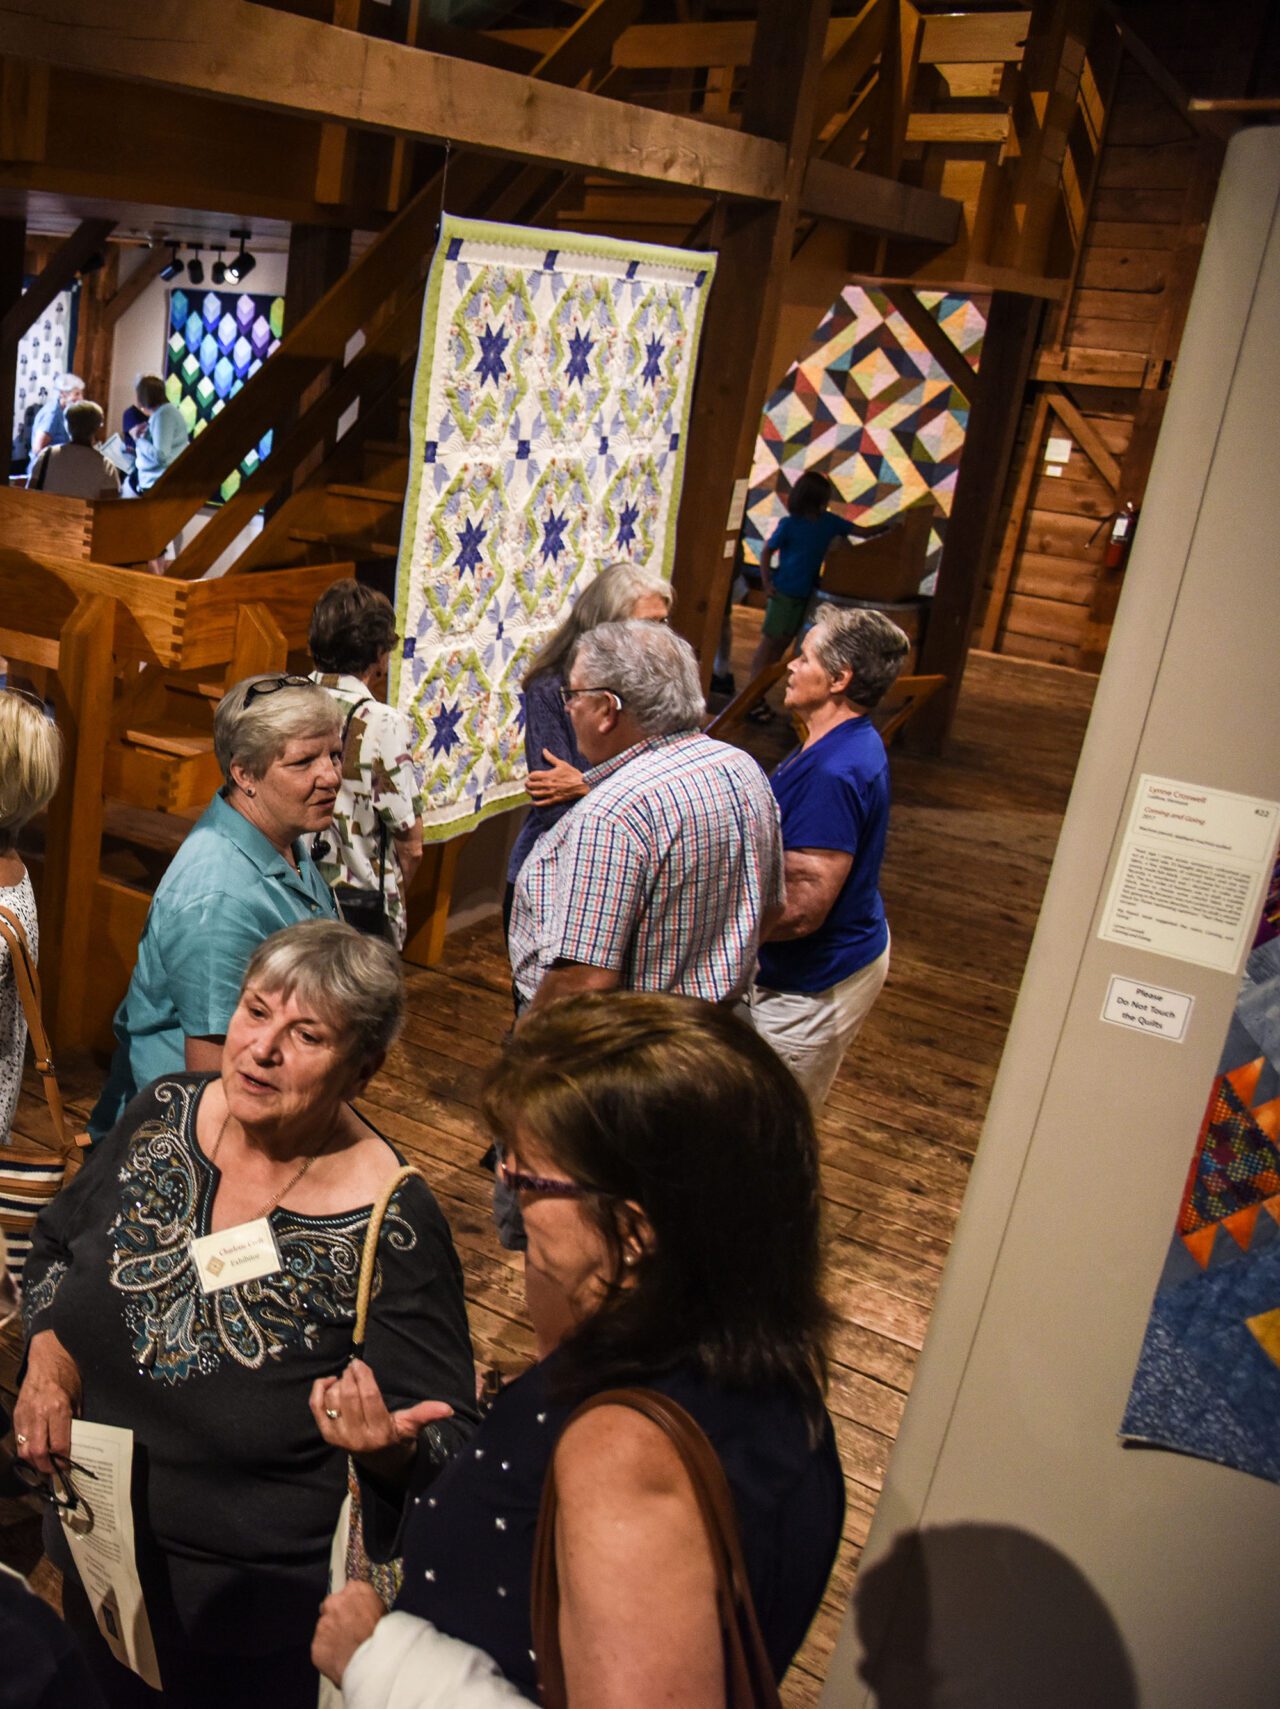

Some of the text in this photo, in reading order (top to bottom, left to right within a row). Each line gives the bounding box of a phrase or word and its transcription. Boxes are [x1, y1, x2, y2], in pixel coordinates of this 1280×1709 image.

[1136, 987, 1163, 1002] Please
[1116, 996, 1176, 1019] Do Not Touch
[1121, 1012, 1163, 1030] the Quilts
